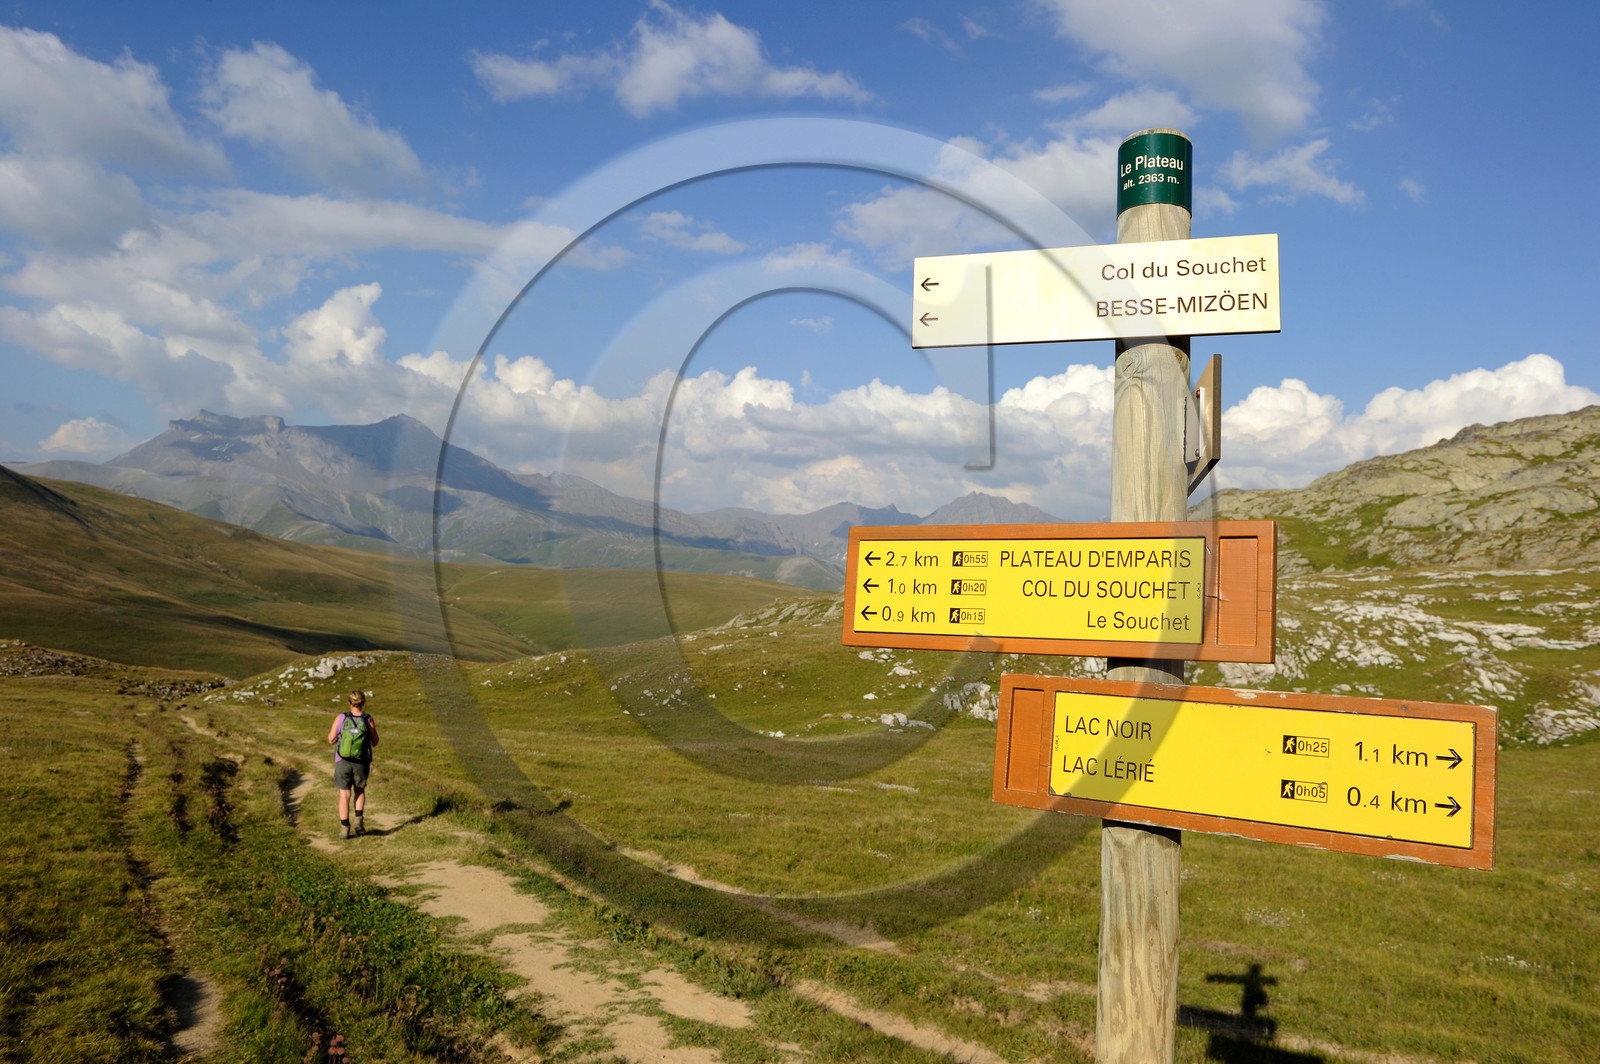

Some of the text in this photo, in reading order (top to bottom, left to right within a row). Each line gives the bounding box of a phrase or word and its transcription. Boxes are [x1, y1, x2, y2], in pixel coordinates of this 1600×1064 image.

[1120, 154, 1184, 178] Le Plateau
[1123, 173, 1180, 191] alt. 2363 m.
[1101, 256, 1267, 281] Col du Souchet
[1096, 290, 1268, 318] BESSE-MIZÖEN
[885, 550, 1192, 568] 2.7 km 0h55 PLATEAU D'EMPARIS
[887, 578, 906, 595] 1.0
[912, 578, 937, 595] km
[962, 582, 985, 593] 0h20
[1022, 579, 1058, 598] COL
[1064, 580, 1090, 598] DU
[1096, 580, 1191, 600] SOUCHET
[881, 605, 1190, 631] 0.9 km 0h15 Le Souchet
[1065, 715, 1429, 767] LAC NOIR 0h25 1.1 km
[1062, 754, 1427, 815] LAC LÉRIÉ 0h05 0.4 km
